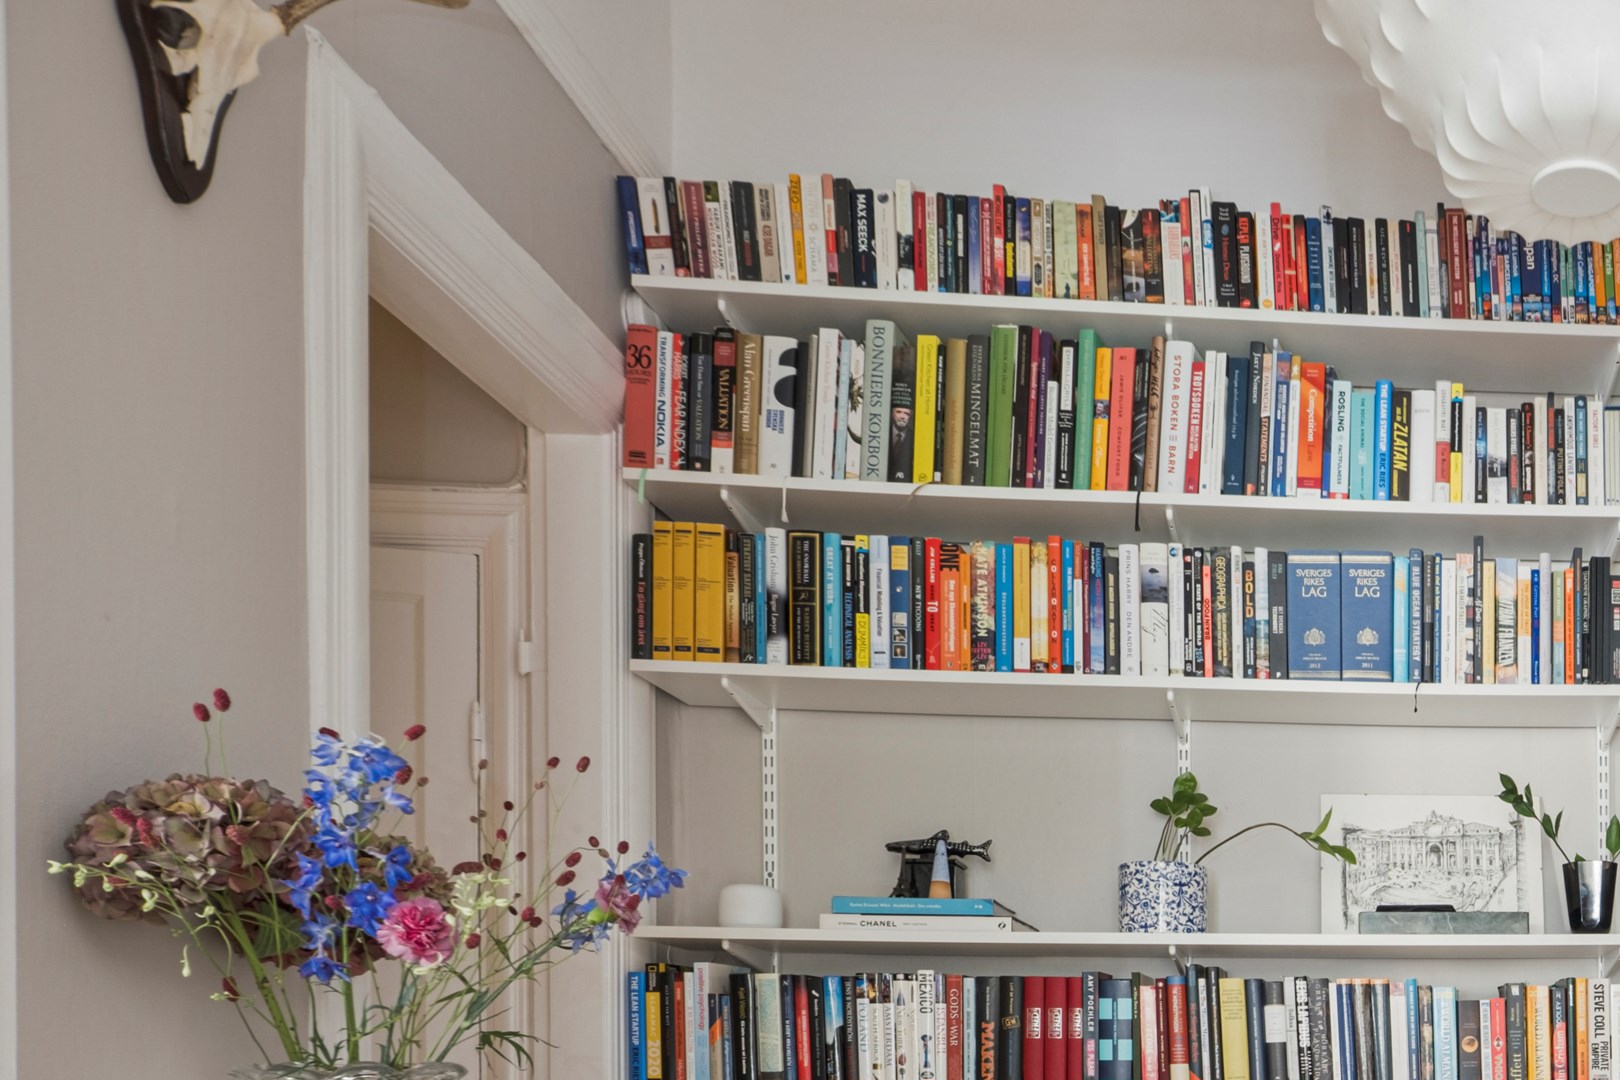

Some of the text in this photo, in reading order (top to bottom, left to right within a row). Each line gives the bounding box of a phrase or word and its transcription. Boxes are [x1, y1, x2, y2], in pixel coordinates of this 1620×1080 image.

[857, 194, 869, 252] MAX SEECK
[1524, 240, 1535, 270] apan
[627, 344, 652, 369] 36
[656, 336, 667, 447] TRANSFORMING NOKIA
[718, 369, 730, 428] VALUATION
[738, 340, 757, 432] Alan Greenspan
[866, 326, 885, 477] BONNIERS KOKBOK
[1190, 371, 1203, 425] TROTSBOKEN
[674, 390, 687, 453] FEAR INDEX
[969, 382, 981, 467] MINGELMAT
[1167, 355, 1182, 474] STORA BOKEN BARN
[1307, 389, 1318, 442] Competition
[1337, 391, 1346, 432] ROSLING
[1393, 422, 1408, 471] ZLATAN
[769, 535, 779, 553] John
[940, 544, 959, 571] ONE
[727, 556, 737, 593] Valuation
[770, 555, 779, 589] Grisham
[826, 571, 833, 581] AT
[1216, 556, 1226, 610] GEOGRAPHICA
[1296, 568, 1332, 578] SVERIGES
[1303, 577, 1324, 586] RIKES
[1348, 568, 1385, 578] SVERIGES
[1356, 577, 1378, 586] RIKES
[1412, 566, 1420, 587] BLUE
[977, 547, 988, 637] KATE ATKINSON
[1245, 570, 1253, 618] BOLD
[1301, 586, 1327, 598] LAG
[1354, 586, 1381, 598] LAG
[1412, 589, 1420, 617] OCEAN
[770, 613, 779, 634] Lawyer
[1498, 628, 1514, 666] FRANZEN
[859, 919, 897, 927] CHANEL
[631, 992, 639, 1011] LEAN
[697, 993, 706, 1030] psychology
[920, 974, 933, 1013] MEXICO
[1594, 984, 1605, 1038] STEVE COLL
[631, 1013, 640, 1045] STARTUP
[859, 1002, 868, 1053] POLAND
[950, 989, 959, 1046] GODS WAR
[1298, 1006, 1310, 1048] LAPIDUS
[885, 1006, 893, 1067] AMSTERDAM
[648, 1039, 661, 1076] 2020
[1591, 1043, 1599, 1070] EMPIRE
[1600, 1041, 1609, 1071] PRIVATE
